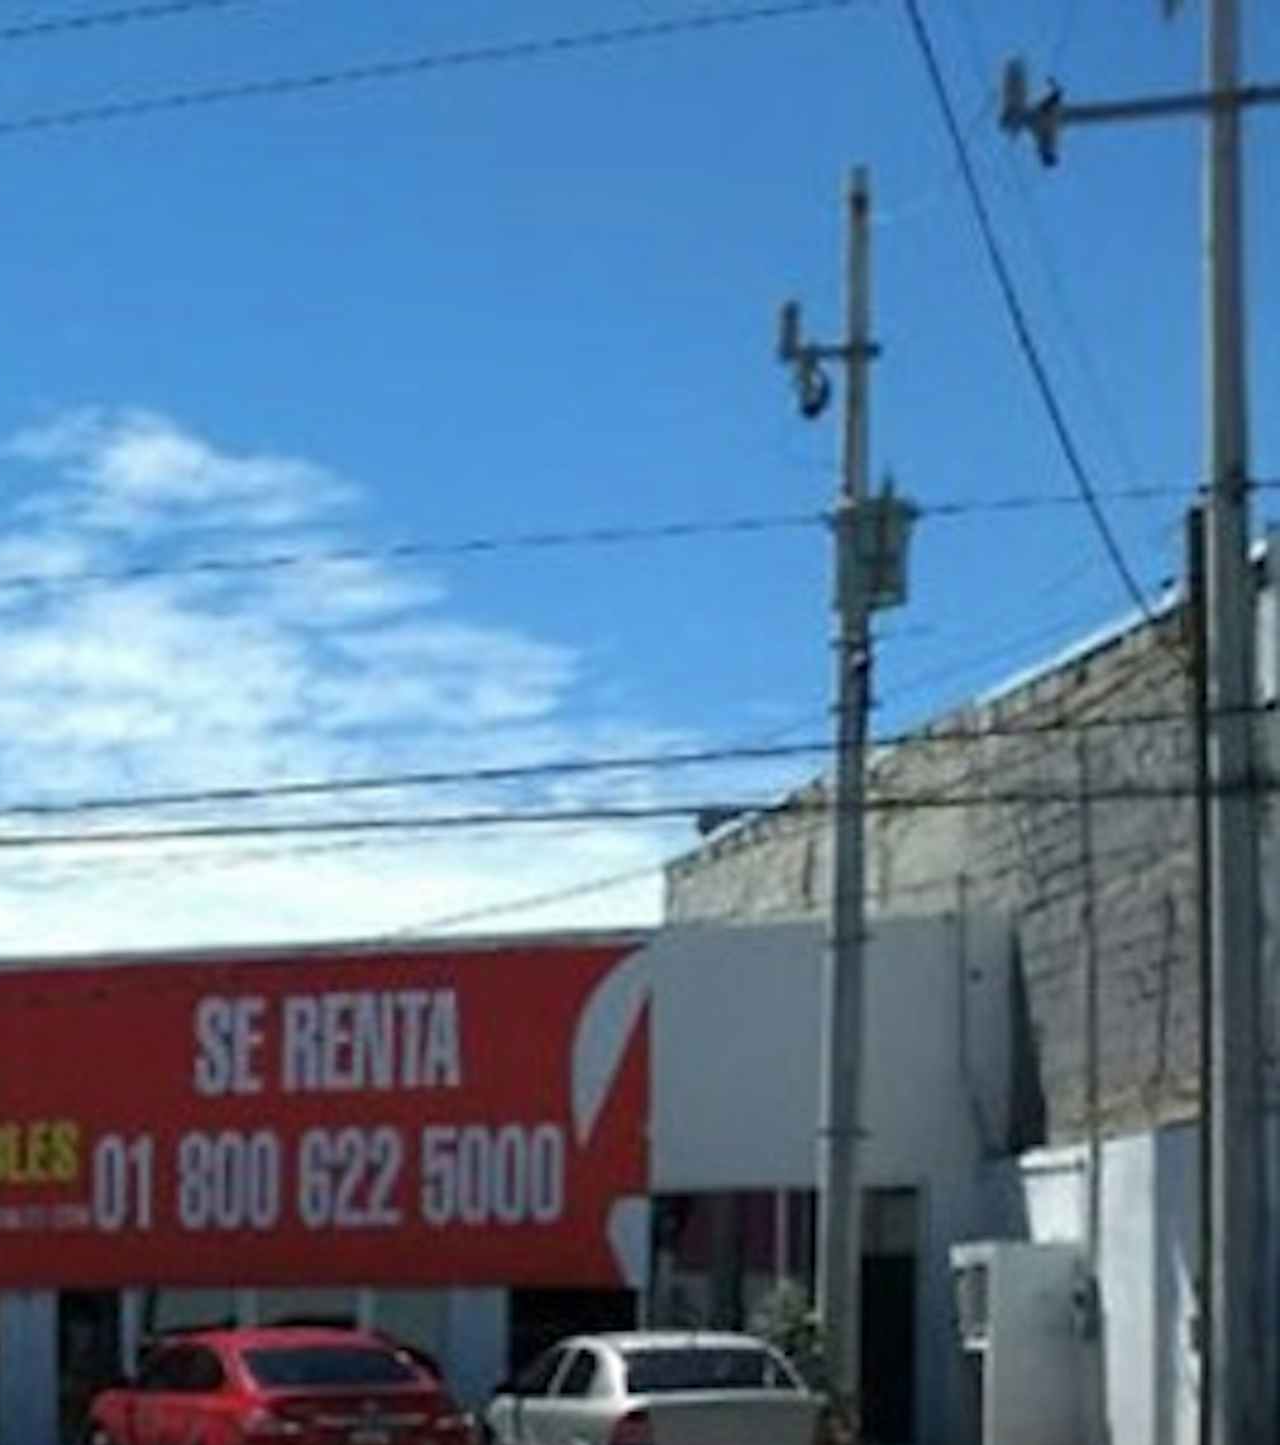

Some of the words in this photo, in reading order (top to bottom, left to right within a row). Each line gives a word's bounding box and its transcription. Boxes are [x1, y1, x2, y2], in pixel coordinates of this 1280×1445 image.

[194, 995, 265, 1096] SE
[282, 989, 462, 1092] RENTA
[93, 1132, 153, 1231] 01
[177, 1128, 280, 1230] 800
[297, 1124, 403, 1229] 622
[421, 1121, 565, 1225] 5000
